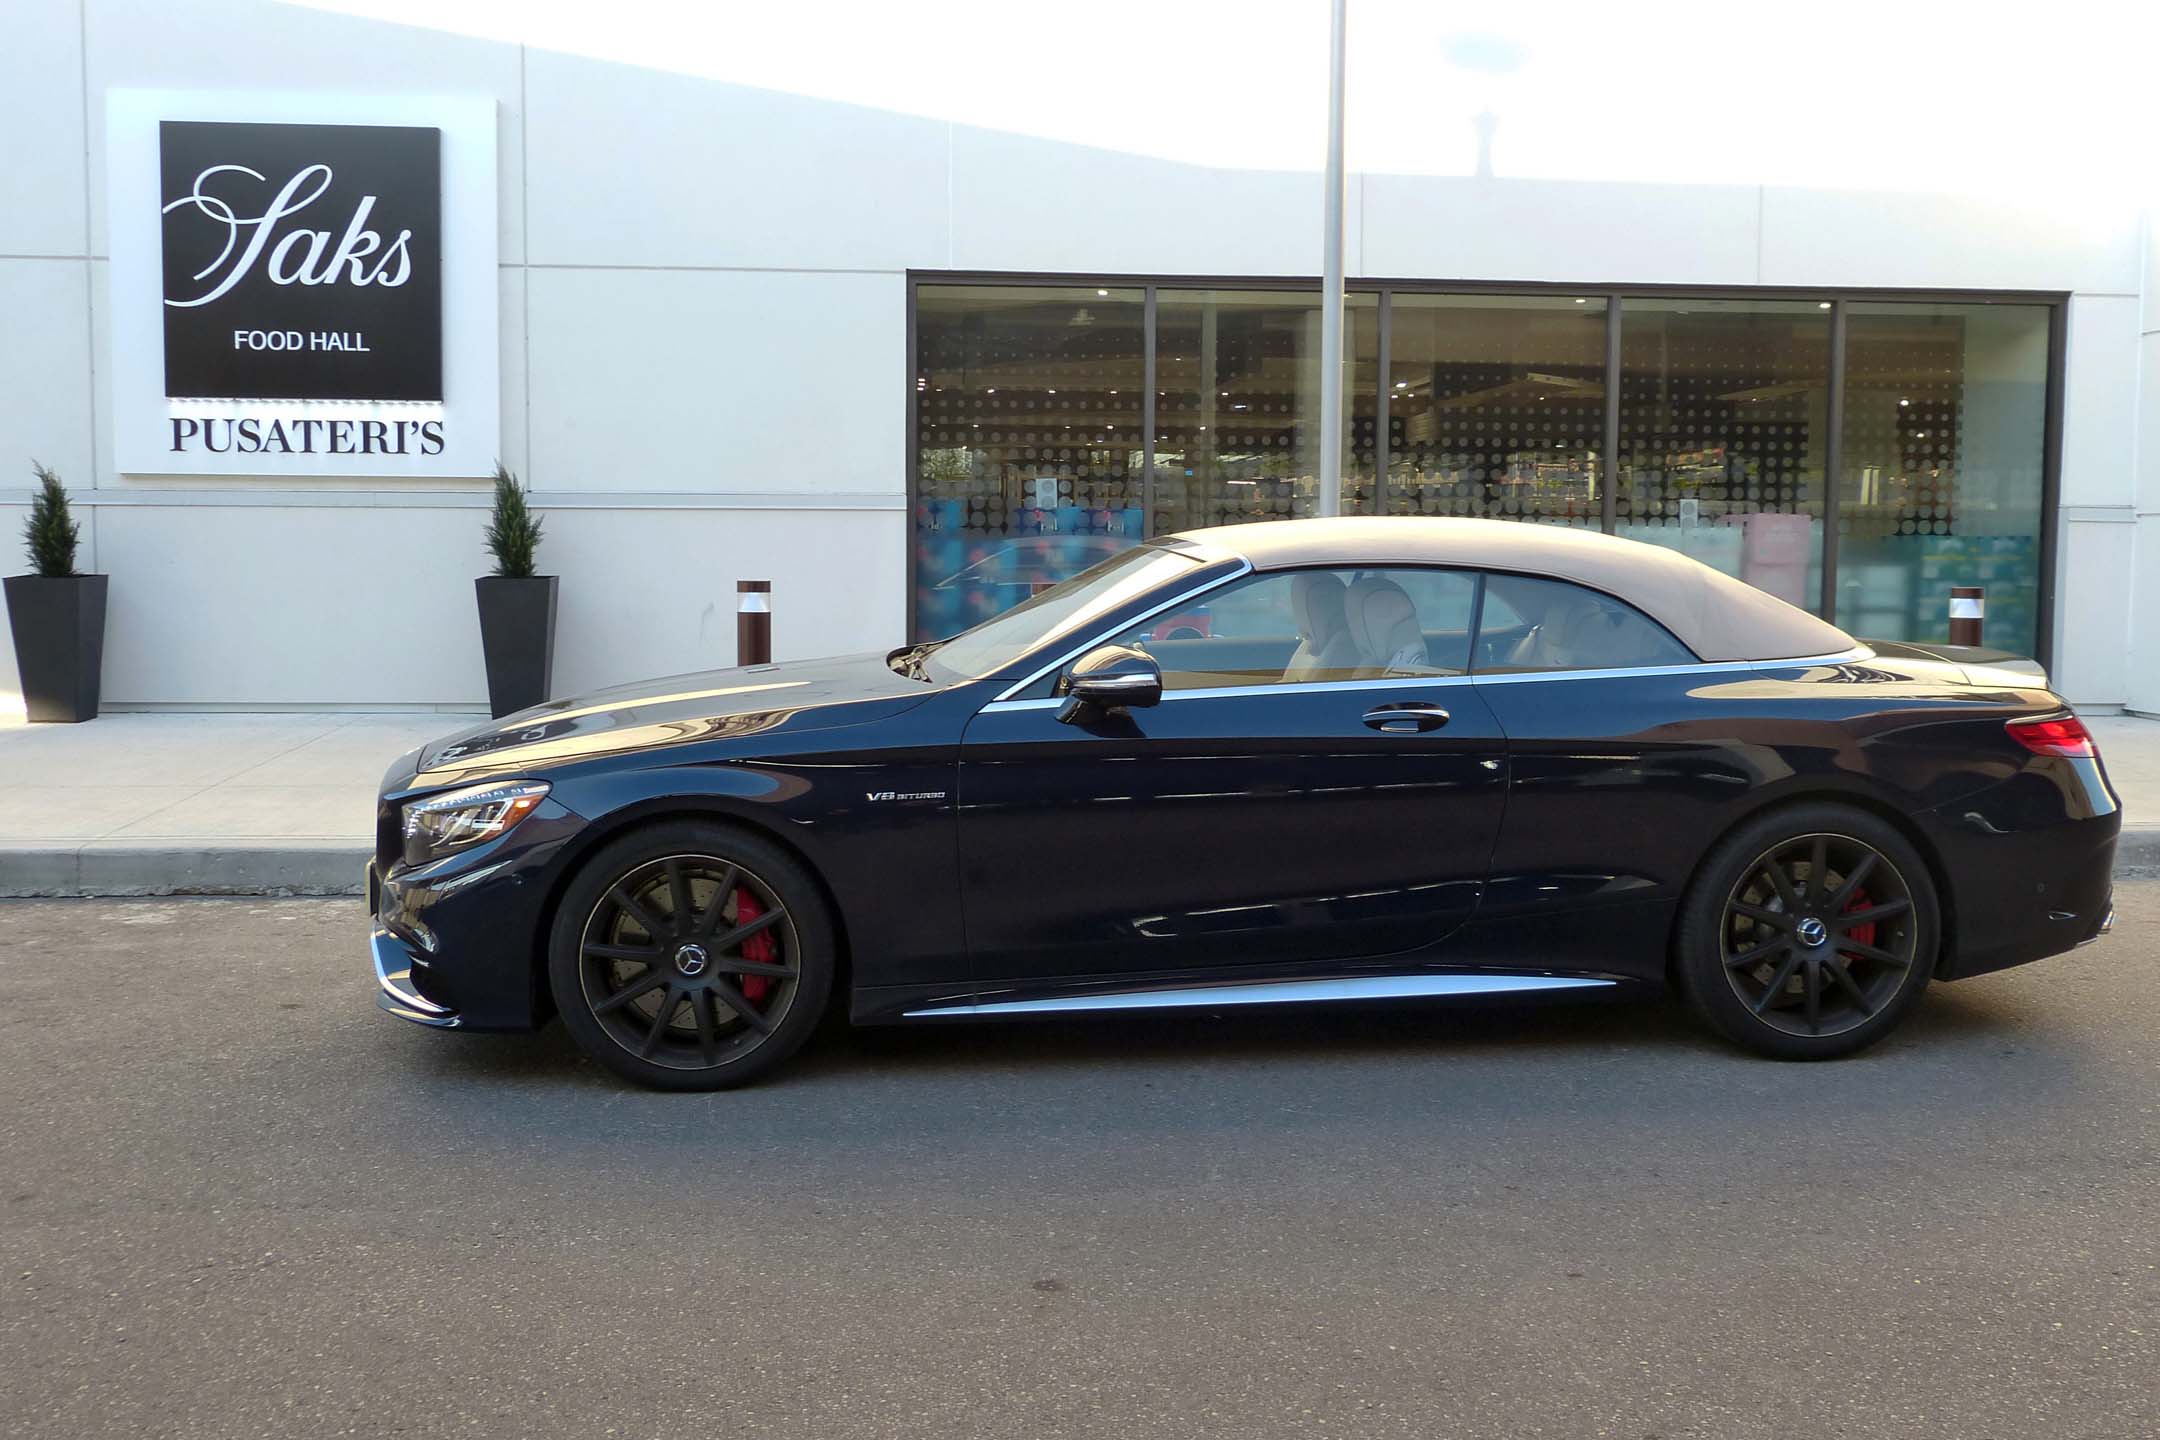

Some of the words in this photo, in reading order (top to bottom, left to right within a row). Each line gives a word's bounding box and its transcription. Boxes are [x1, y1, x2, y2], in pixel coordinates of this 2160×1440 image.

[162, 164, 412, 307] Saks
[234, 330, 303, 351] FOOD
[310, 331, 370, 352] HALL
[169, 418, 445, 455] PUSATERI'S
[897, 792, 945, 800] BITURBO
